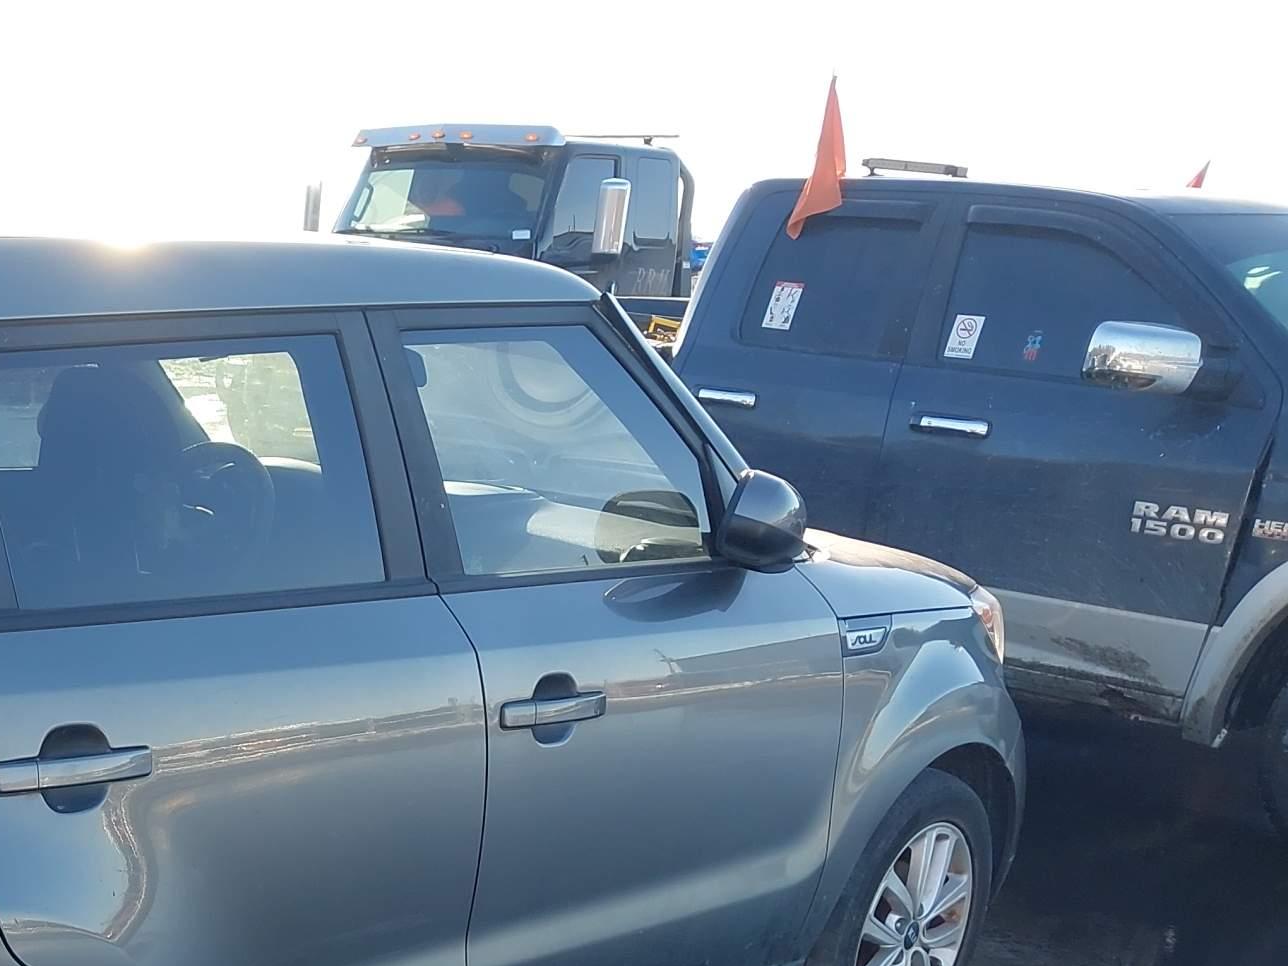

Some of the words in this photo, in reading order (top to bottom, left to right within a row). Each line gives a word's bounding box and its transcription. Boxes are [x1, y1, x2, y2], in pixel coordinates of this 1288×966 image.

[947, 346, 973, 354] SMOKING
[1132, 500, 1229, 528] RAM
[1130, 517, 1225, 545] 1500
